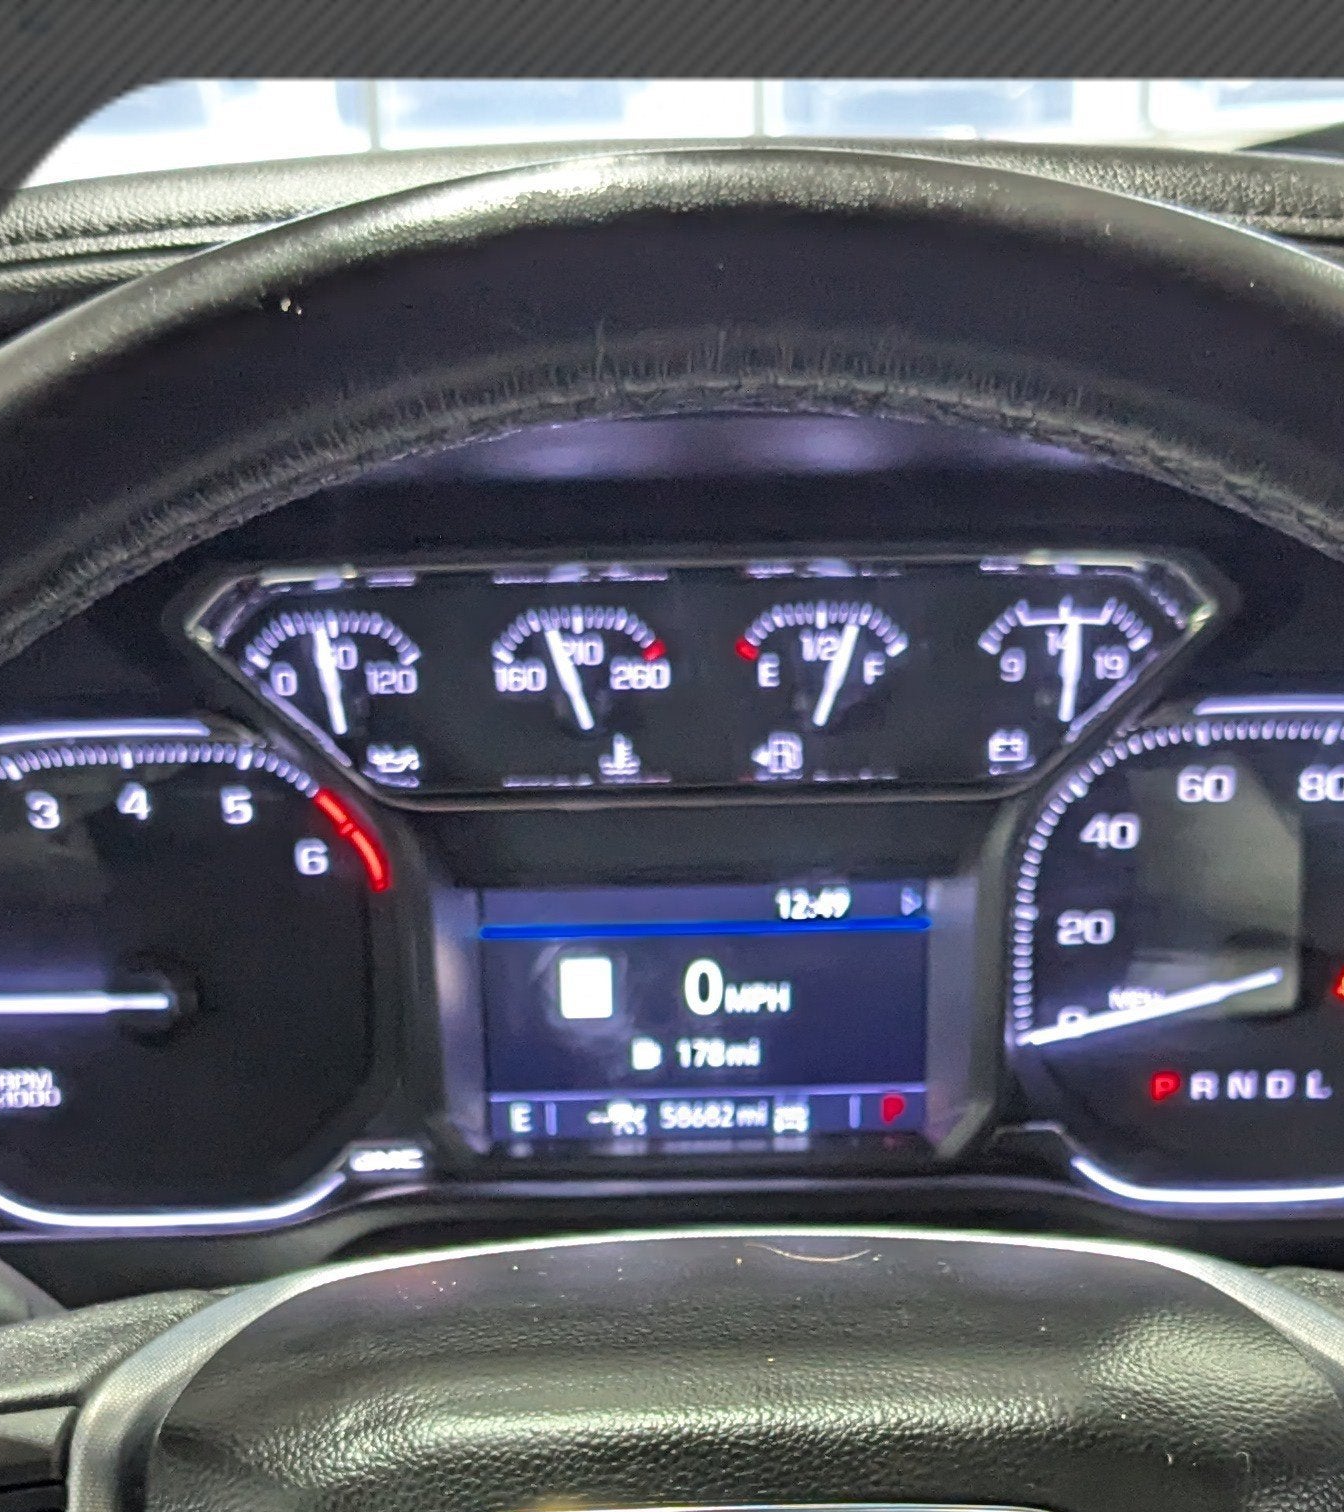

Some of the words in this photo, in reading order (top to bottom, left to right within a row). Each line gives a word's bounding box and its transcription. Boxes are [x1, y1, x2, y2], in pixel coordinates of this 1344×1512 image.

[271, 662, 297, 695] 0
[367, 662, 418, 695] 120
[495, 659, 546, 692] 160
[610, 657, 670, 690] 260
[758, 653, 780, 687] E
[864, 652, 885, 685] F
[1000, 647, 1026, 682] 9
[1093, 646, 1129, 680] 19
[118, 783, 150, 819] 4
[1177, 766, 1236, 802] 60
[27, 792, 60, 828] 3
[222, 787, 252, 824] 5
[1080, 813, 1139, 849] 40
[295, 839, 327, 875] 6
[1058, 910, 1115, 945] 20
[684, 958, 724, 1016] 0
[1152, 1071, 1181, 1100] P
[1190, 1071, 1219, 1100] R
[1227, 1070, 1257, 1099] N
[1306, 1069, 1332, 1099] L
